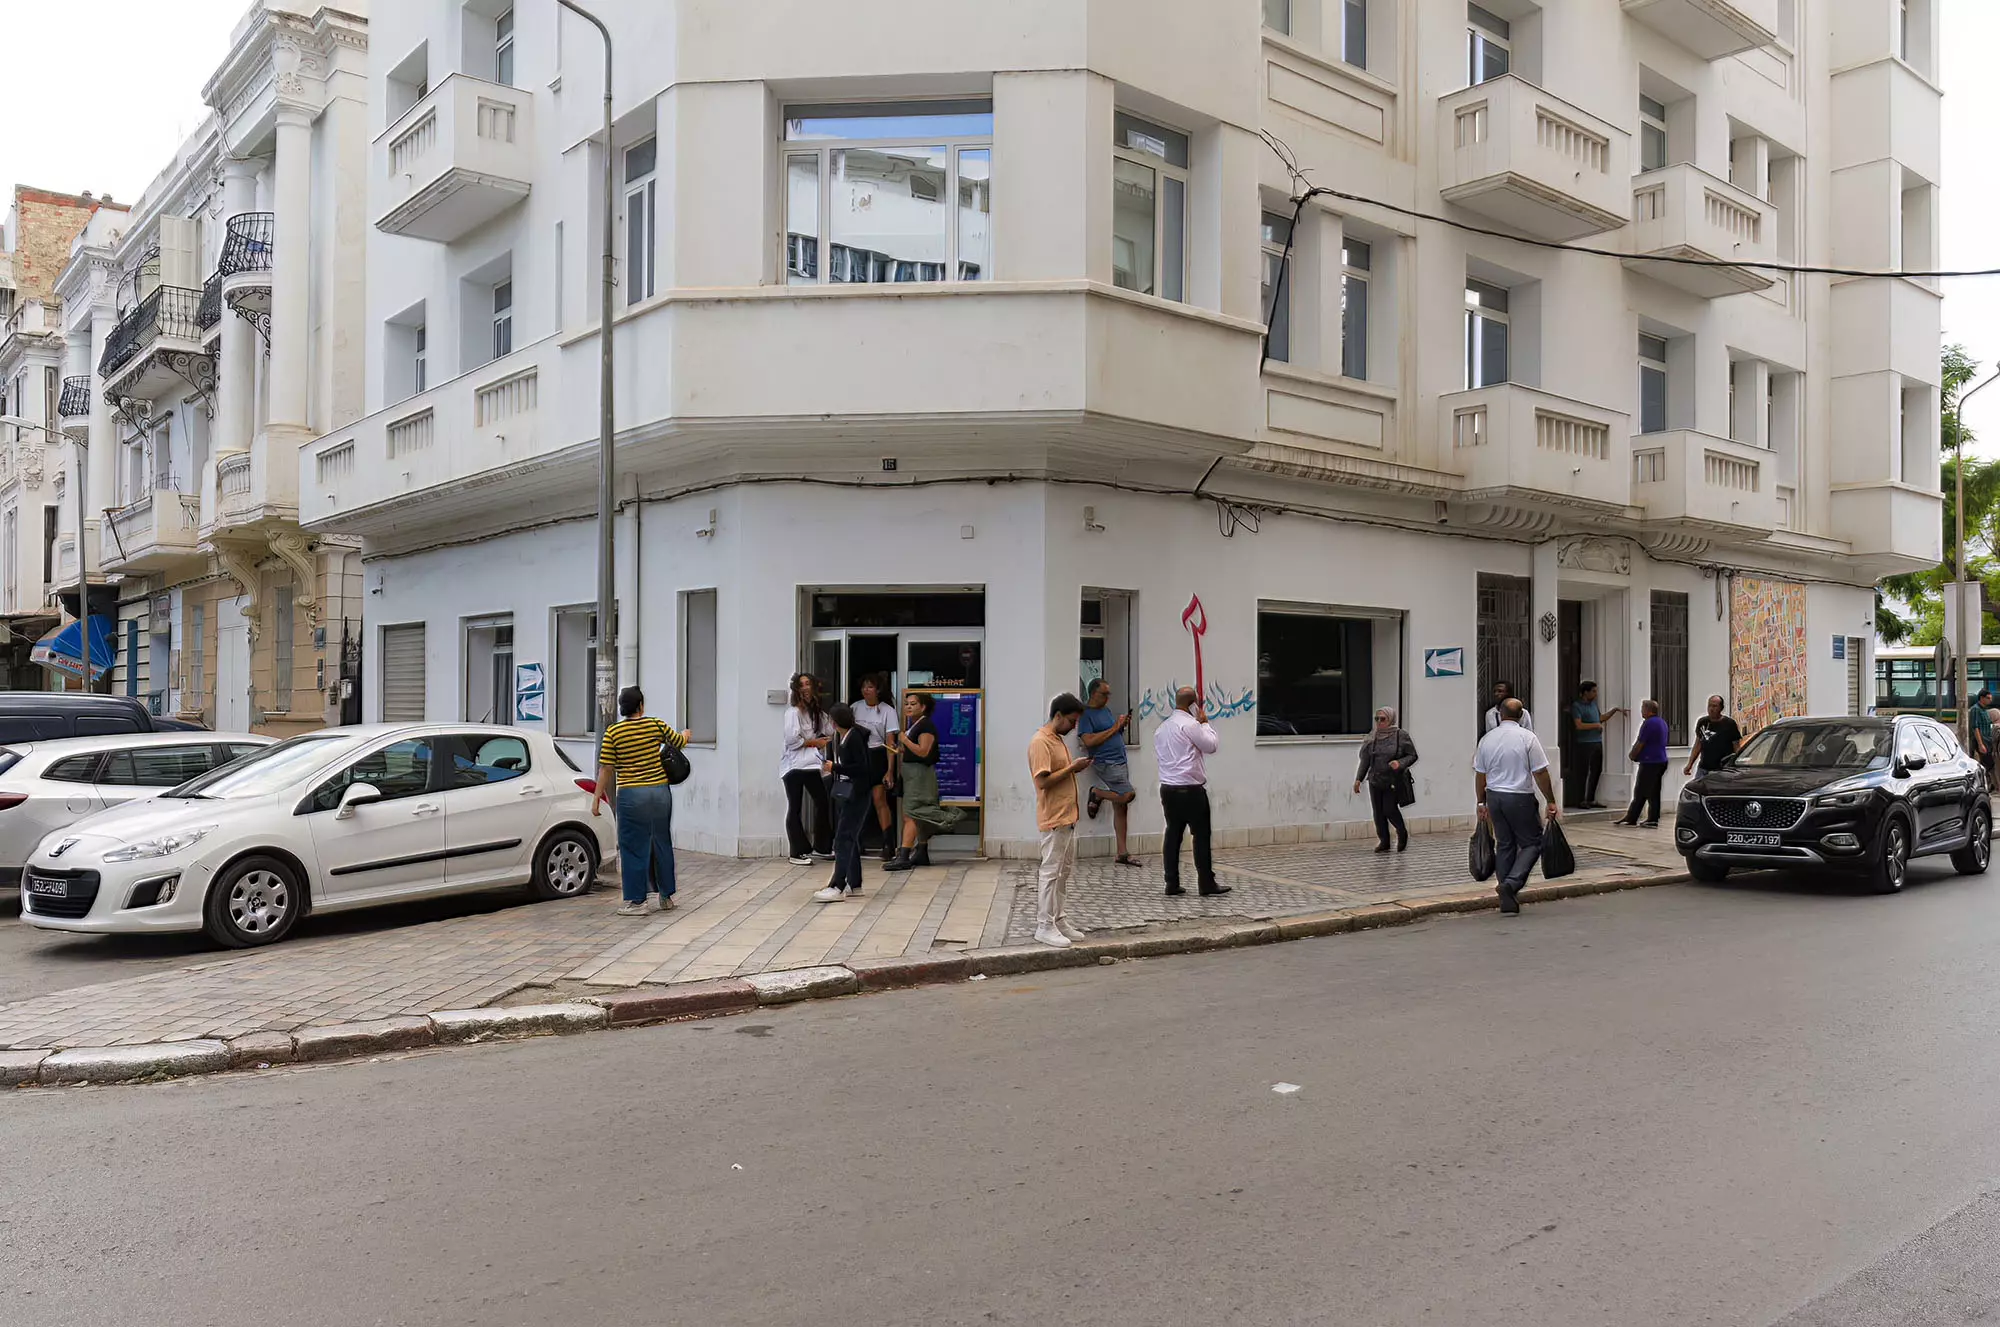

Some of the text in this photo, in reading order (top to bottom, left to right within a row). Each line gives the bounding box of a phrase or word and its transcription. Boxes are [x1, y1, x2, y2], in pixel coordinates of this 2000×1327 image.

[154, 696, 160, 705] P
[949, 703, 959, 735] Dream
[959, 716, 970, 735] City
[1727, 834, 1744, 843] 220
[1757, 835, 1779, 845] 7197
